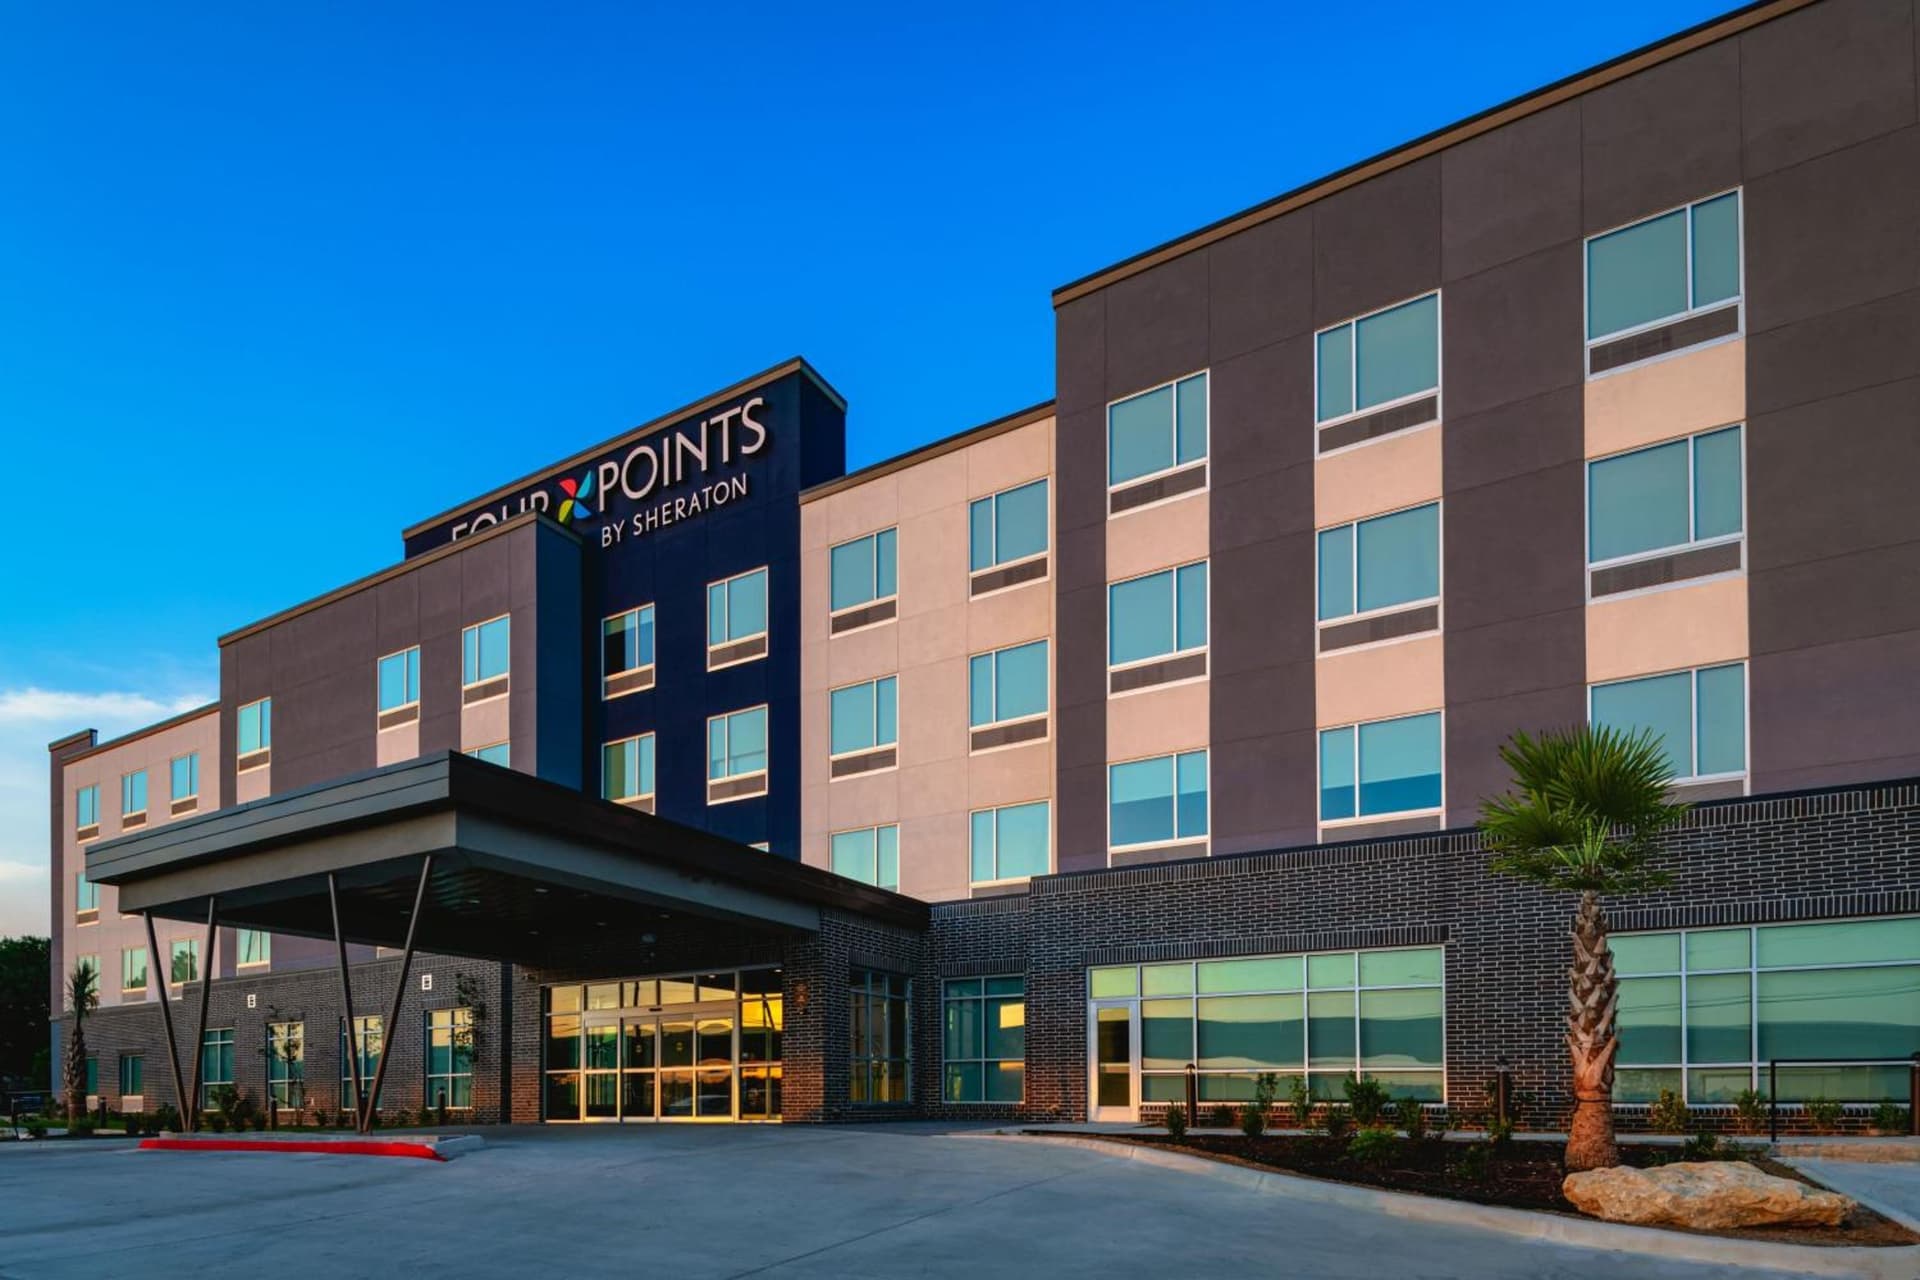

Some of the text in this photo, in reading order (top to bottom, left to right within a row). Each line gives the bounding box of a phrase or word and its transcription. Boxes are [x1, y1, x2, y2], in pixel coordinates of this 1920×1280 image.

[598, 397, 767, 513] POINTS
[601, 472, 747, 548] BY SHERATON
